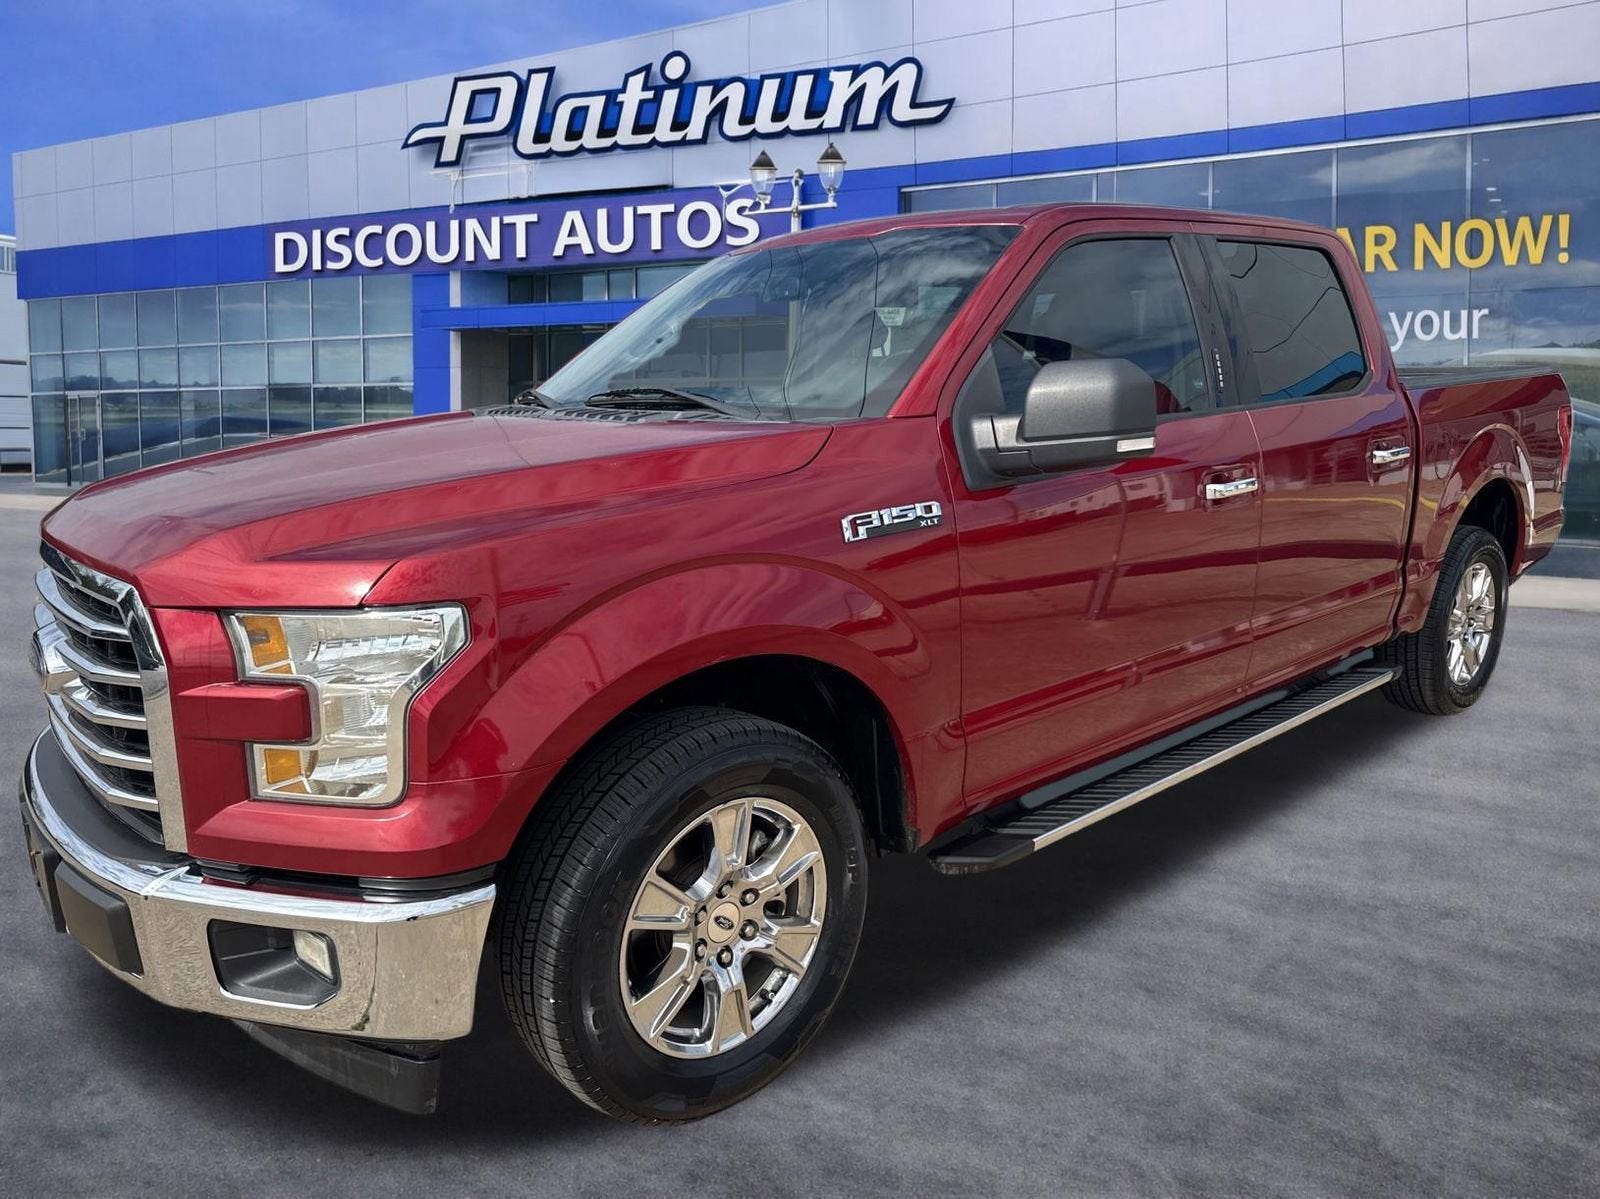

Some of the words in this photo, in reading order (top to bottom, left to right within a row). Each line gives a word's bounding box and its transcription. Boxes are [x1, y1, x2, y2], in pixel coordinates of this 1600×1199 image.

[403, 50, 956, 168] Platinum
[274, 214, 538, 274] DISCOUNT
[553, 198, 760, 258] AUTOS
[1413, 213, 1571, 271] NOW!
[1388, 307, 1489, 350] your
[919, 518, 939, 527] XLT
